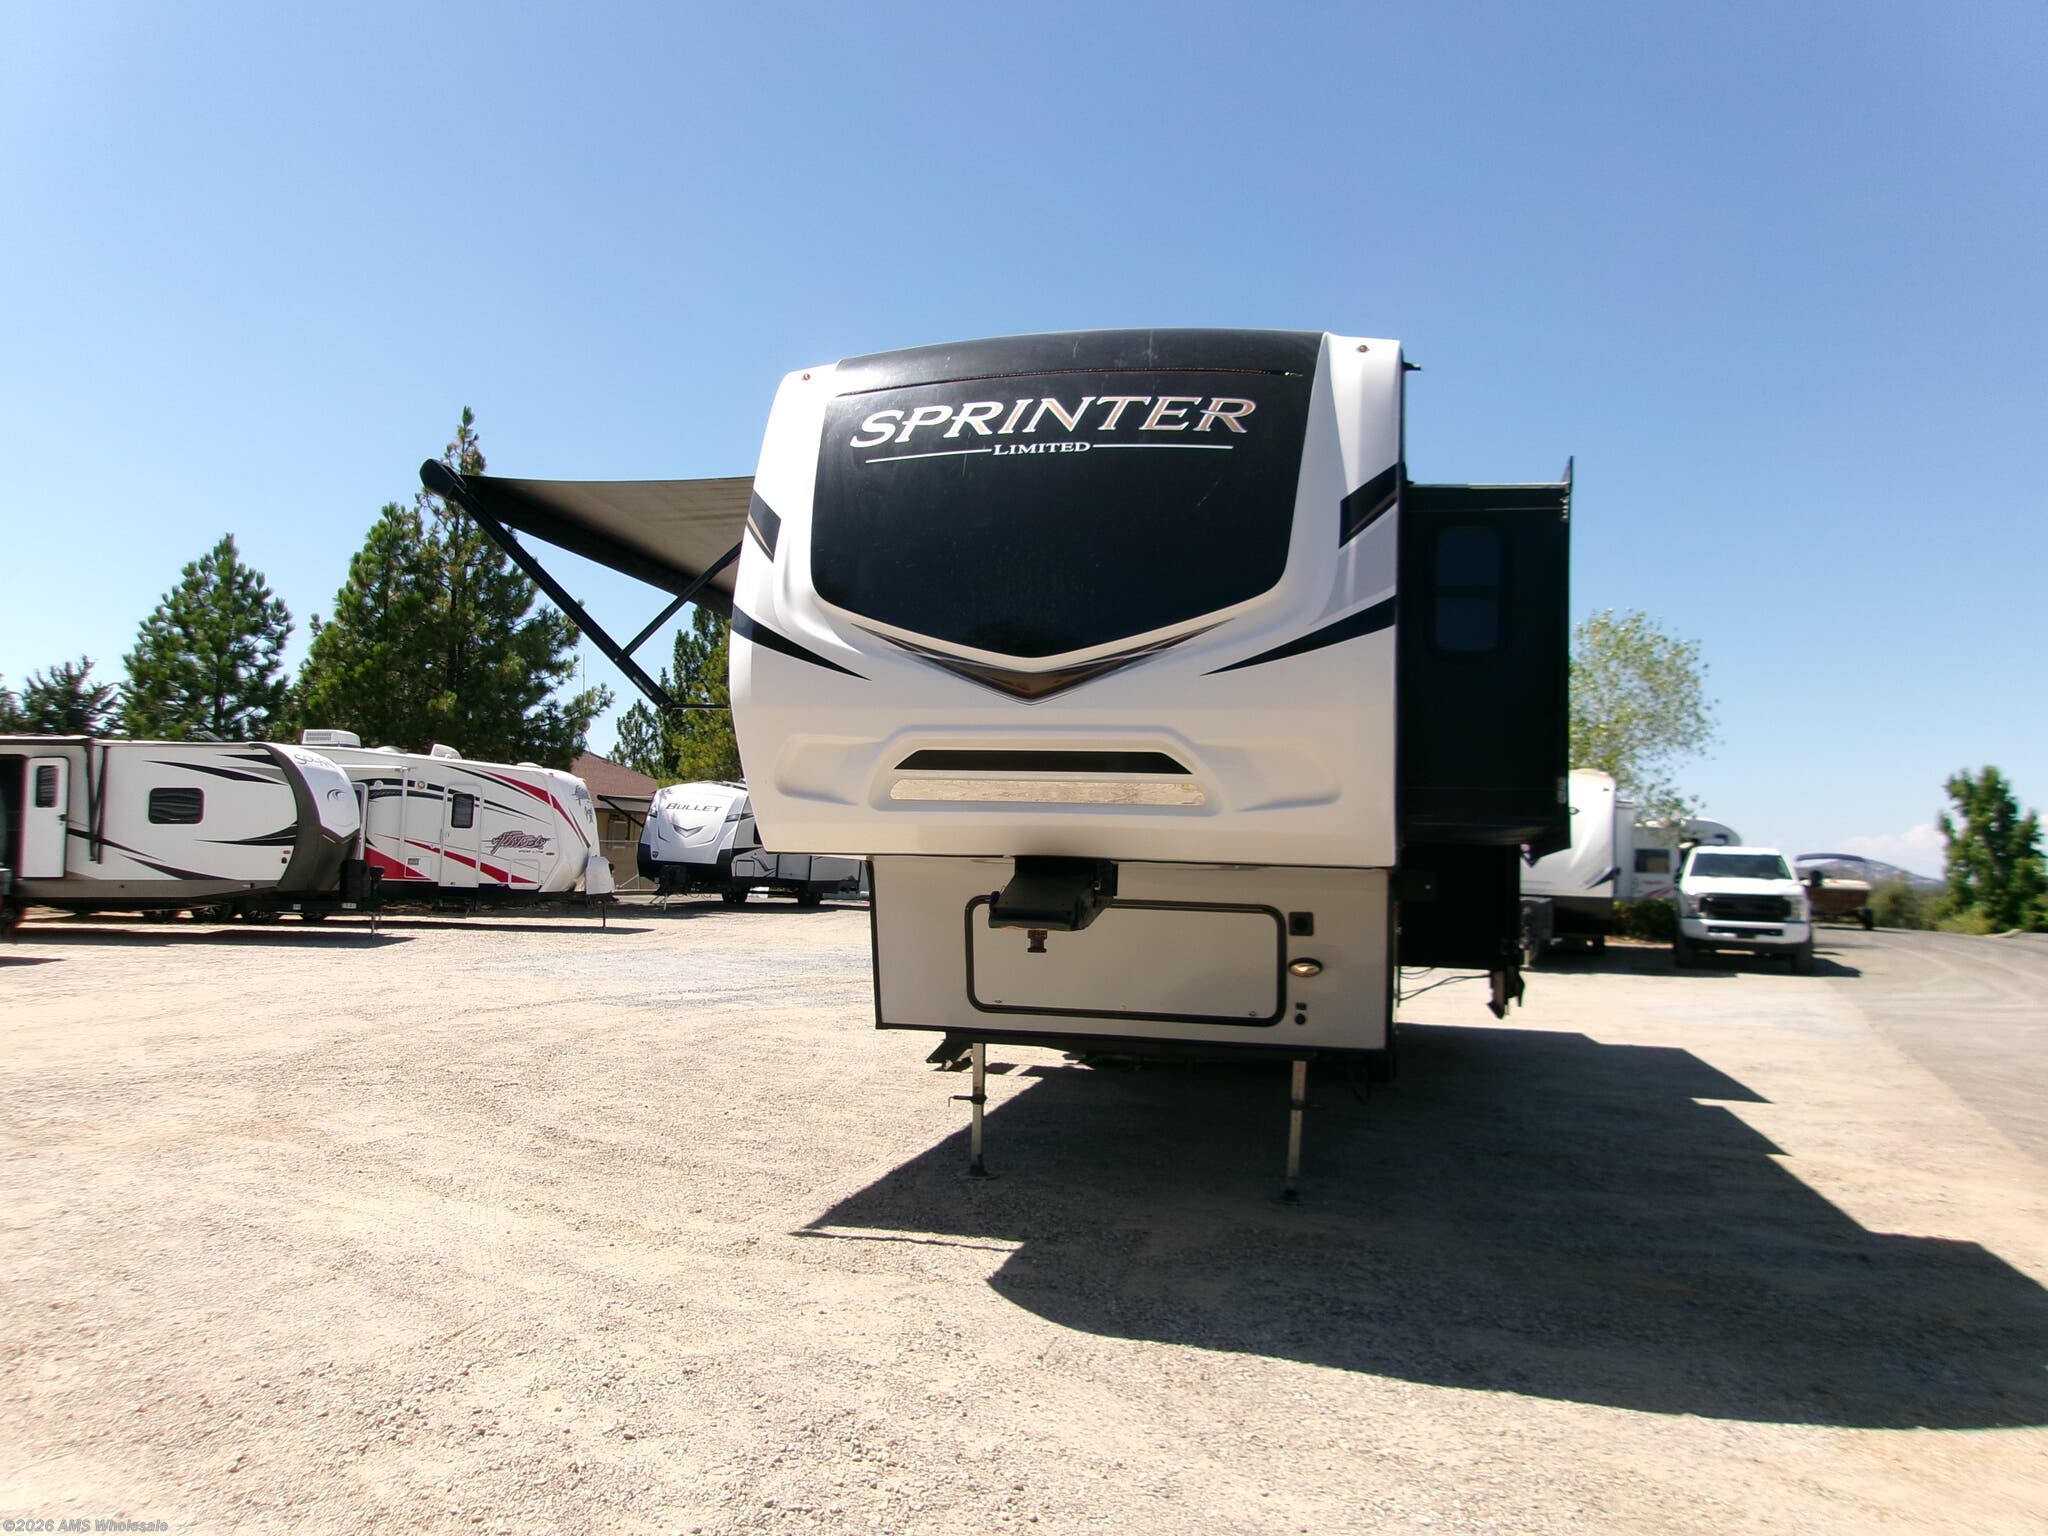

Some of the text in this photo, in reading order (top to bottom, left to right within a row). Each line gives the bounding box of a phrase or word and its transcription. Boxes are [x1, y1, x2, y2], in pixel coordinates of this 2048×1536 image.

[850, 396, 1256, 447] SPRINTER
[993, 441, 1091, 455] LIMITED
[665, 802, 722, 812] BULLET
